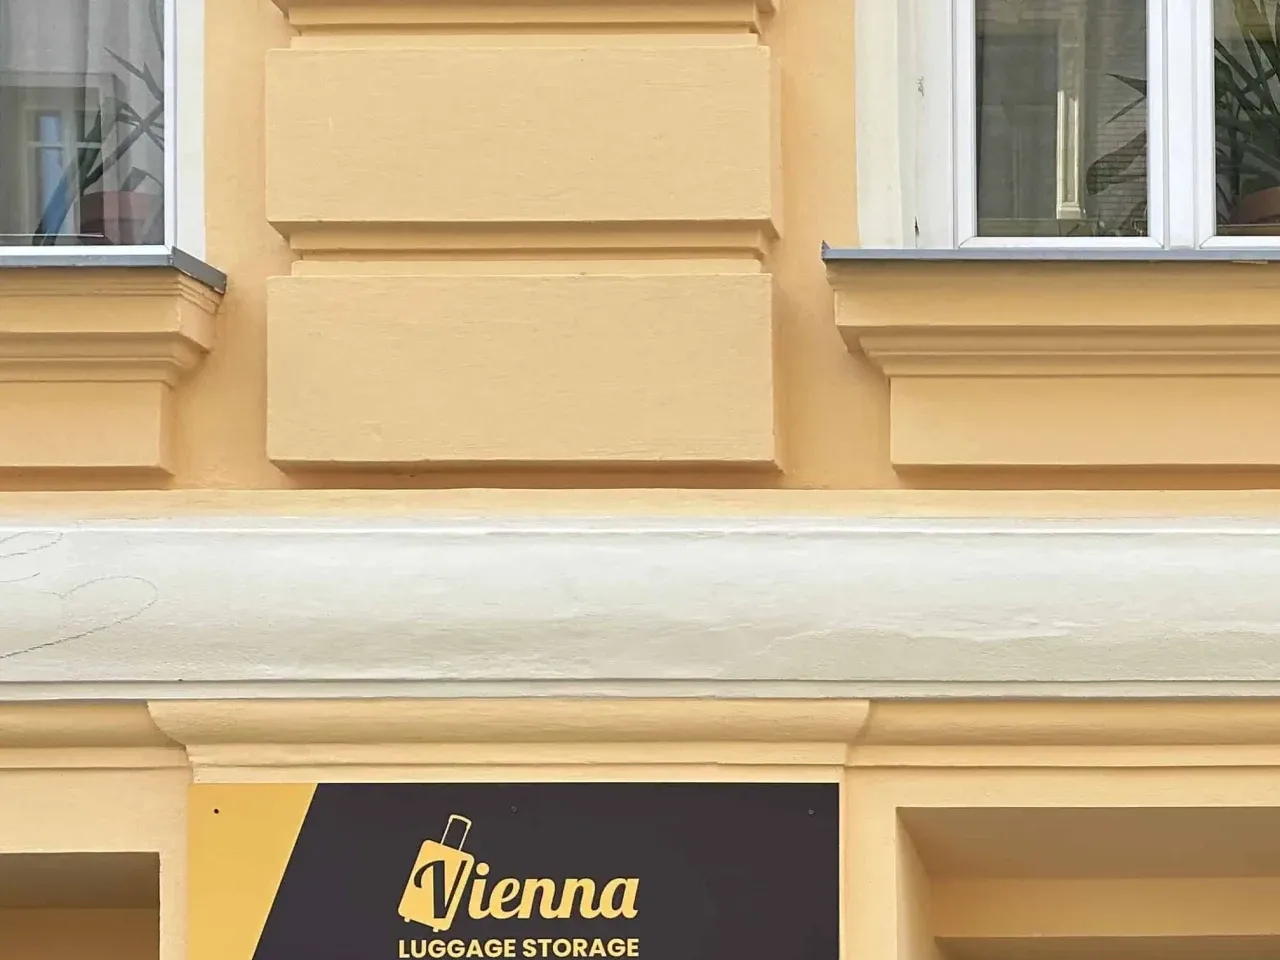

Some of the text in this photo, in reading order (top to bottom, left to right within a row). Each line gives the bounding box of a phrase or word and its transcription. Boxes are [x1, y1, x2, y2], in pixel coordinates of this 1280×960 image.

[413, 859, 640, 920] Vienna
[398, 938, 640, 959] LUGGAGE STORAGE
